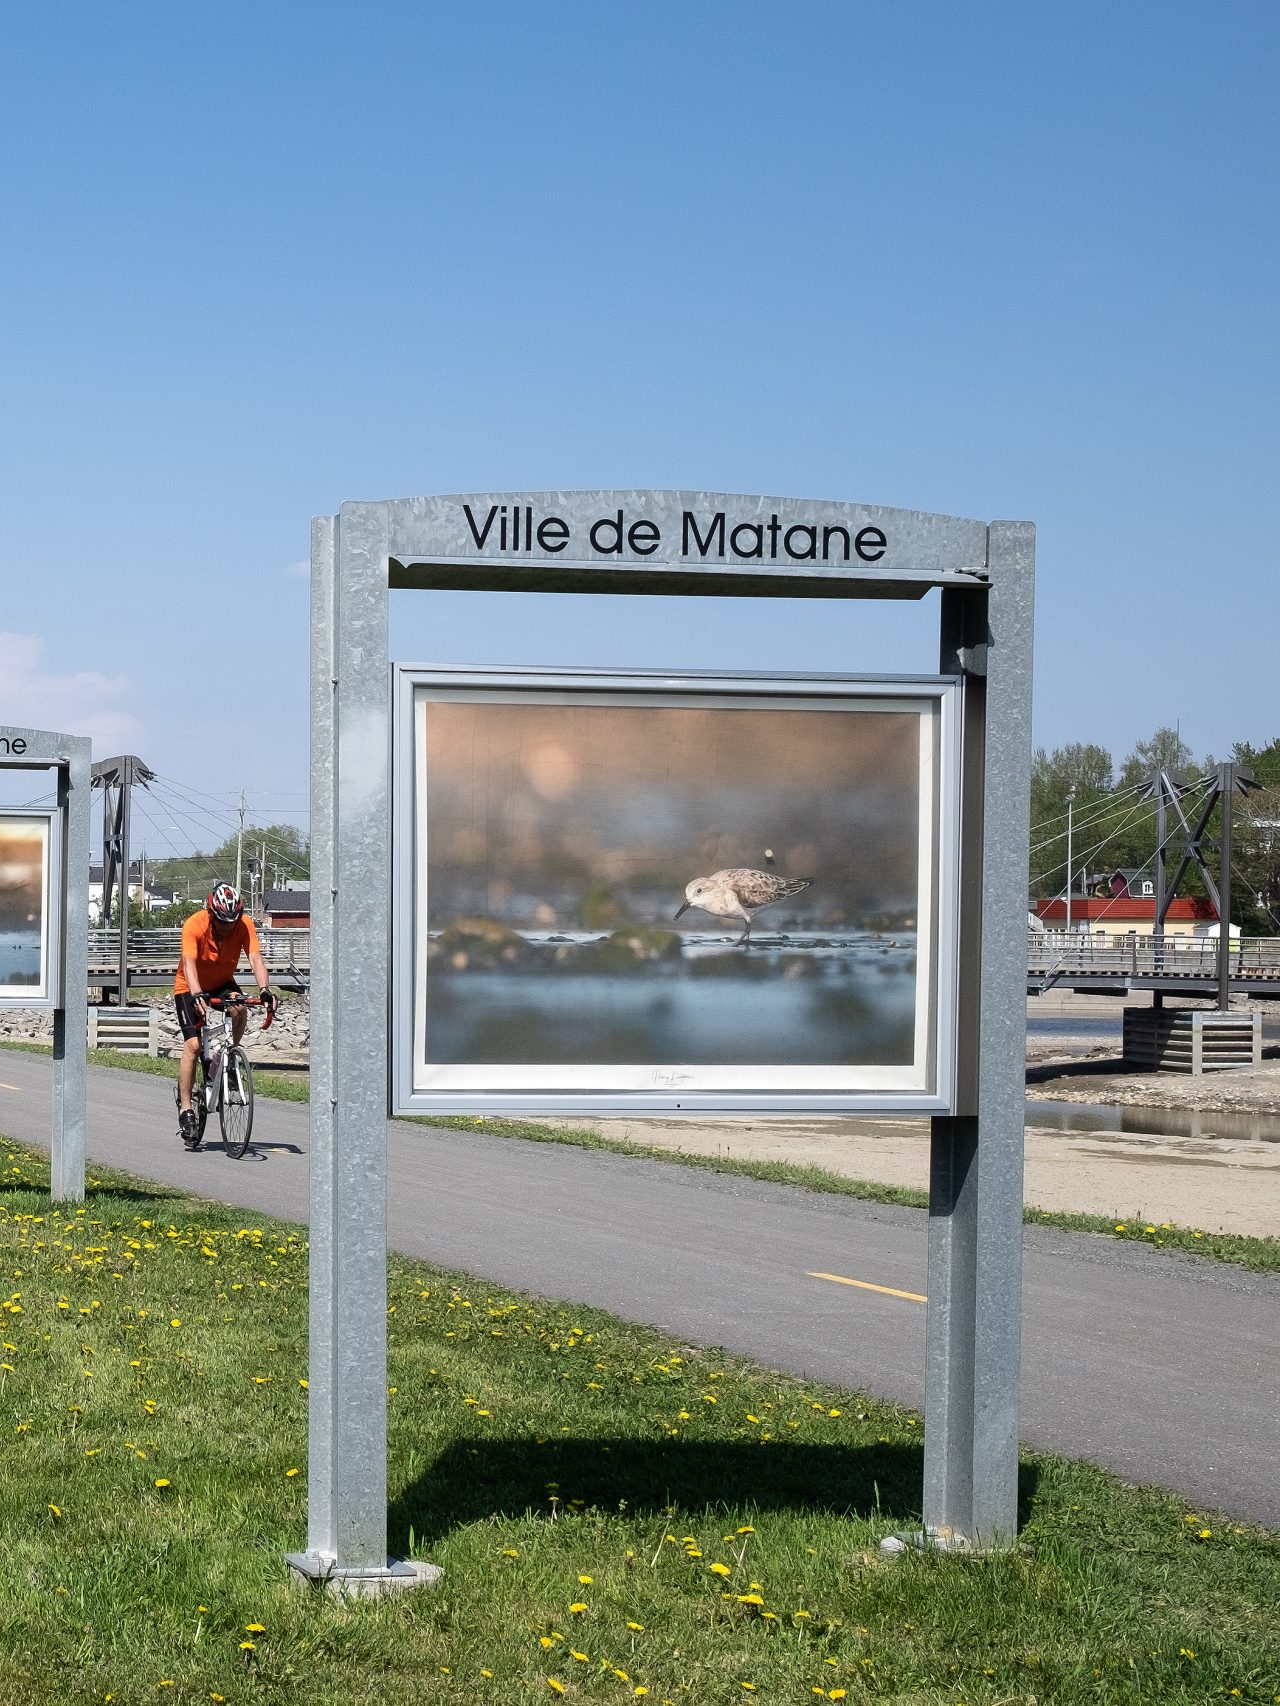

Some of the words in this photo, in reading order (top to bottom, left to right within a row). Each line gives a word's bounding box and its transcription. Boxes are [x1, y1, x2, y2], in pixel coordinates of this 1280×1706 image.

[462, 504, 570, 553] Ville
[589, 509, 661, 556] de
[682, 511, 888, 562] Matane
